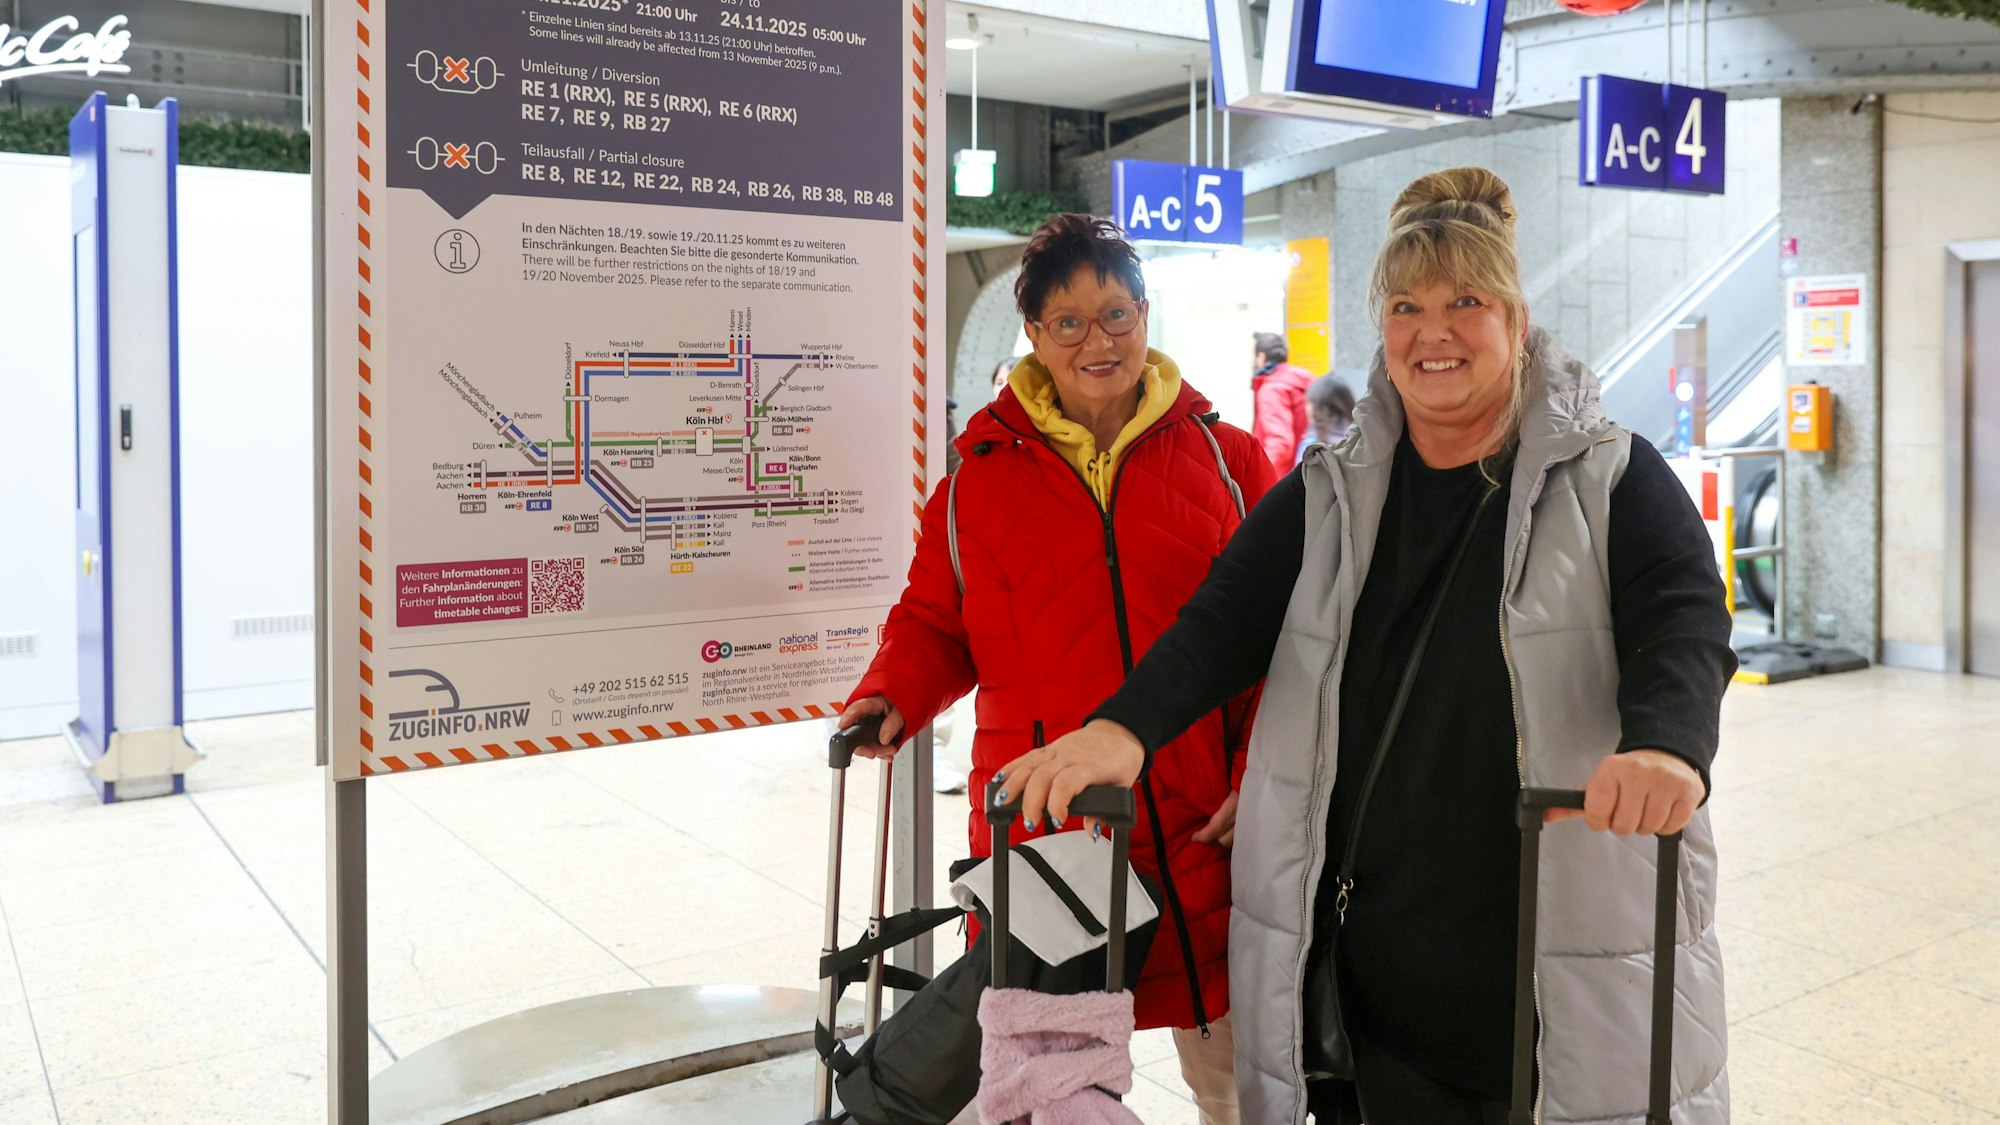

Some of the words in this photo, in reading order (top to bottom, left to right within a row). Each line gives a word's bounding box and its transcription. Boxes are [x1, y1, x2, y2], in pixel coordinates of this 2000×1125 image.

[636, 2, 672, 19] 21:00
[674, 7, 698, 22] Uhr
[529, 10, 572, 26] Einzelne
[574, 17, 604, 30] Linien
[606, 21, 627, 33] sind
[629, 23, 662, 38] bereits
[664, 29, 676, 40] ab
[679, 30, 720, 45] 13.11.25
[721, 36, 751, 49] (21:00
[753, 40, 772, 54] Uhr)
[774, 43, 816, 58] betroffen.
[720, 10, 807, 37] 24.11.2025
[812, 27, 844, 43] 05:00
[846, 32, 866, 46] Uhr
[0, 14, 131, 77] cCafé
[528, 25, 558, 39] Some
[560, 29, 584, 42] lines
[585, 33, 603, 45] will
[605, 35, 641, 51] already
[643, 39, 655, 51] be
[657, 42, 696, 56] affected
[698, 46, 720, 59] from
[722, 50, 734, 61] 13
[736, 51, 783, 67] November
[784, 57, 807, 70] 2025
[808, 61, 817, 72] (9
[819, 64, 842, 75] p.m.).
[521, 58, 588, 80] Umleitung
[591, 66, 598, 79] /
[602, 67, 660, 86] Diversion
[521, 79, 544, 97] RE
[549, 82, 559, 99] 1
[564, 82, 615, 107] (RRX),
[624, 89, 645, 107] RE
[650, 92, 659, 108] 5
[663, 93, 711, 116] (RRX),
[719, 100, 739, 117] RE
[742, 103, 753, 118] 6
[756, 103, 797, 126] (RRX)
[521, 103, 544, 121] RE
[548, 105, 564, 125] 7,
[573, 108, 595, 126] RE
[599, 111, 614, 130] 9,
[623, 113, 646, 130] RB
[650, 116, 670, 132] 27
[1604, 123, 1661, 172] A-C
[1675, 97, 1707, 174] 4
[520, 142, 584, 160] Teilausfall
[588, 148, 595, 161] /
[599, 149, 638, 164] Partial
[641, 153, 684, 168] closure
[522, 163, 545, 180] RE
[549, 165, 564, 185] 8,
[573, 167, 596, 184] RE
[600, 169, 625, 189] 12,
[634, 172, 655, 189] RE
[658, 173, 683, 193] 22,
[691, 176, 713, 193] RB
[716, 178, 740, 197] 24,
[748, 181, 769, 197] RB
[772, 183, 795, 201] 26,
[802, 185, 822, 201] RB
[825, 187, 847, 205] 38,
[854, 189, 873, 205] RB
[876, 191, 893, 206] 48
[1129, 194, 1182, 231] A-C
[1194, 174, 1223, 233] 5
[522, 221, 532, 233] In
[535, 222, 556, 234] den
[559, 224, 604, 237] Nächten
[607, 226, 645, 239] 18./19.
[648, 230, 677, 241] sowie
[680, 231, 743, 245] 19./20.11.25
[746, 234, 779, 247] kommt
[781, 239, 791, 247] es
[793, 240, 804, 248] zu
[806, 239, 845, 250] weiteren
[522, 237, 617, 254] Einschränkungen.
[620, 242, 668, 255] Beachten
[670, 245, 686, 256] Sie
[688, 246, 711, 258] bitte
[713, 247, 728, 258] die
[730, 250, 783, 261] gesonderte
[786, 251, 858, 265] Kommunikation.
[521, 253, 553, 266] There
[556, 255, 574, 266] will
[577, 255, 591, 267] be
[593, 256, 630, 269] further
[632, 259, 689, 272] restrictions
[691, 263, 704, 272] on
[706, 262, 722, 273] the
[725, 263, 753, 276] nights
[755, 264, 765, 275] of
[768, 265, 796, 276] 18/19
[798, 267, 815, 277] and
[522, 269, 556, 281] 19/20
[559, 271, 615, 283] November
[617, 273, 647, 285] 2025.
[650, 274, 682, 286] Please
[684, 276, 708, 287] refer
[710, 278, 720, 288] to
[723, 277, 739, 288] the
[741, 280, 781, 291] separate
[782, 281, 852, 293] communication.
[594, 395, 629, 403] Dormagen
[686, 415, 706, 425] Köln
[708, 415, 724, 424] Hbf
[472, 442, 496, 450] Düren
[603, 448, 619, 456] Köln
[621, 447, 655, 457] Hansaring
[789, 464, 818, 472] Flughafen
[498, 490, 552, 499] Köln-Ehrenfeld
[461, 504, 473, 512] RB
[475, 503, 485, 511] 38
[562, 514, 579, 522] Köln
[580, 513, 599, 521] West
[588, 523, 598, 531] 24
[671, 550, 731, 560] Hürth-Kalscheuren
[400, 570, 439, 581] Weitere
[441, 566, 510, 579] Informationen
[401, 584, 420, 594] den
[422, 579, 522, 594] Fahrplanänderungen:
[399, 597, 435, 608] Further
[437, 593, 494, 605] information
[496, 591, 523, 601] about
[433, 606, 480, 618] timetable
[482, 605, 522, 615] changes:
[778, 632, 818, 645] national
[826, 626, 869, 637] TransRegio
[734, 642, 772, 653] RHEINLAND
[778, 642, 819, 655] express
[572, 682, 595, 694] +49
[598, 679, 621, 692] 202
[624, 676, 646, 690] 515
[649, 674, 664, 687] 62
[667, 672, 688, 685] 515
[572, 703, 675, 722] www.zuginfo.nrw
[389, 708, 531, 741] ZUGINFO.NRW
